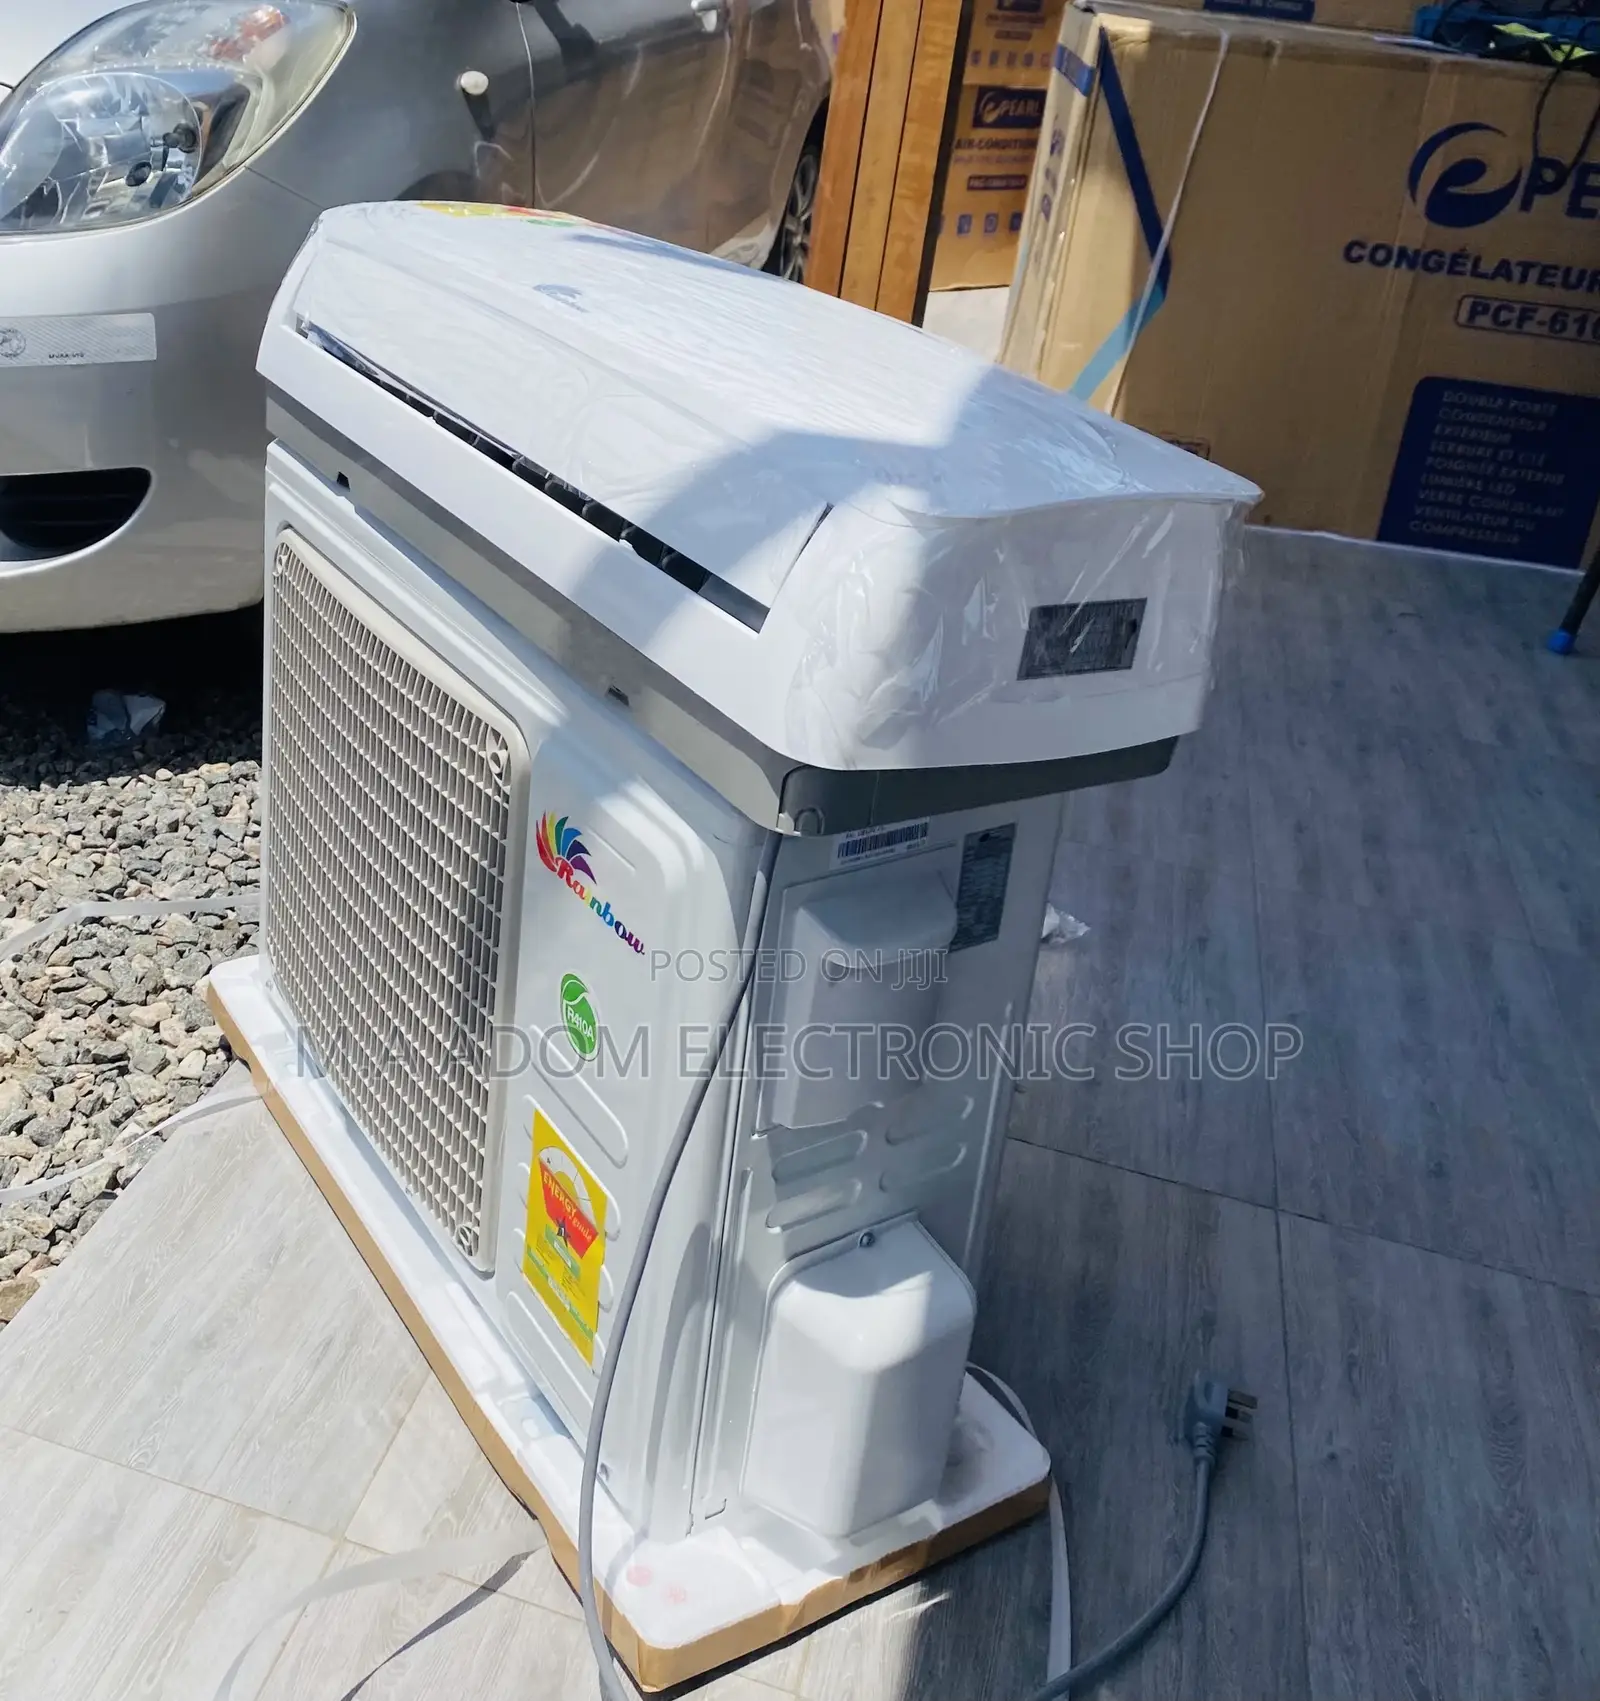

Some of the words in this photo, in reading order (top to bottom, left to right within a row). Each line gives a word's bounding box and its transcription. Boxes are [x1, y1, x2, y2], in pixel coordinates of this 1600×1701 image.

[555, 856, 645, 956] Rainbow
[566, 1005, 594, 1043] R410A
[543, 1171, 577, 1217] ENERGY
